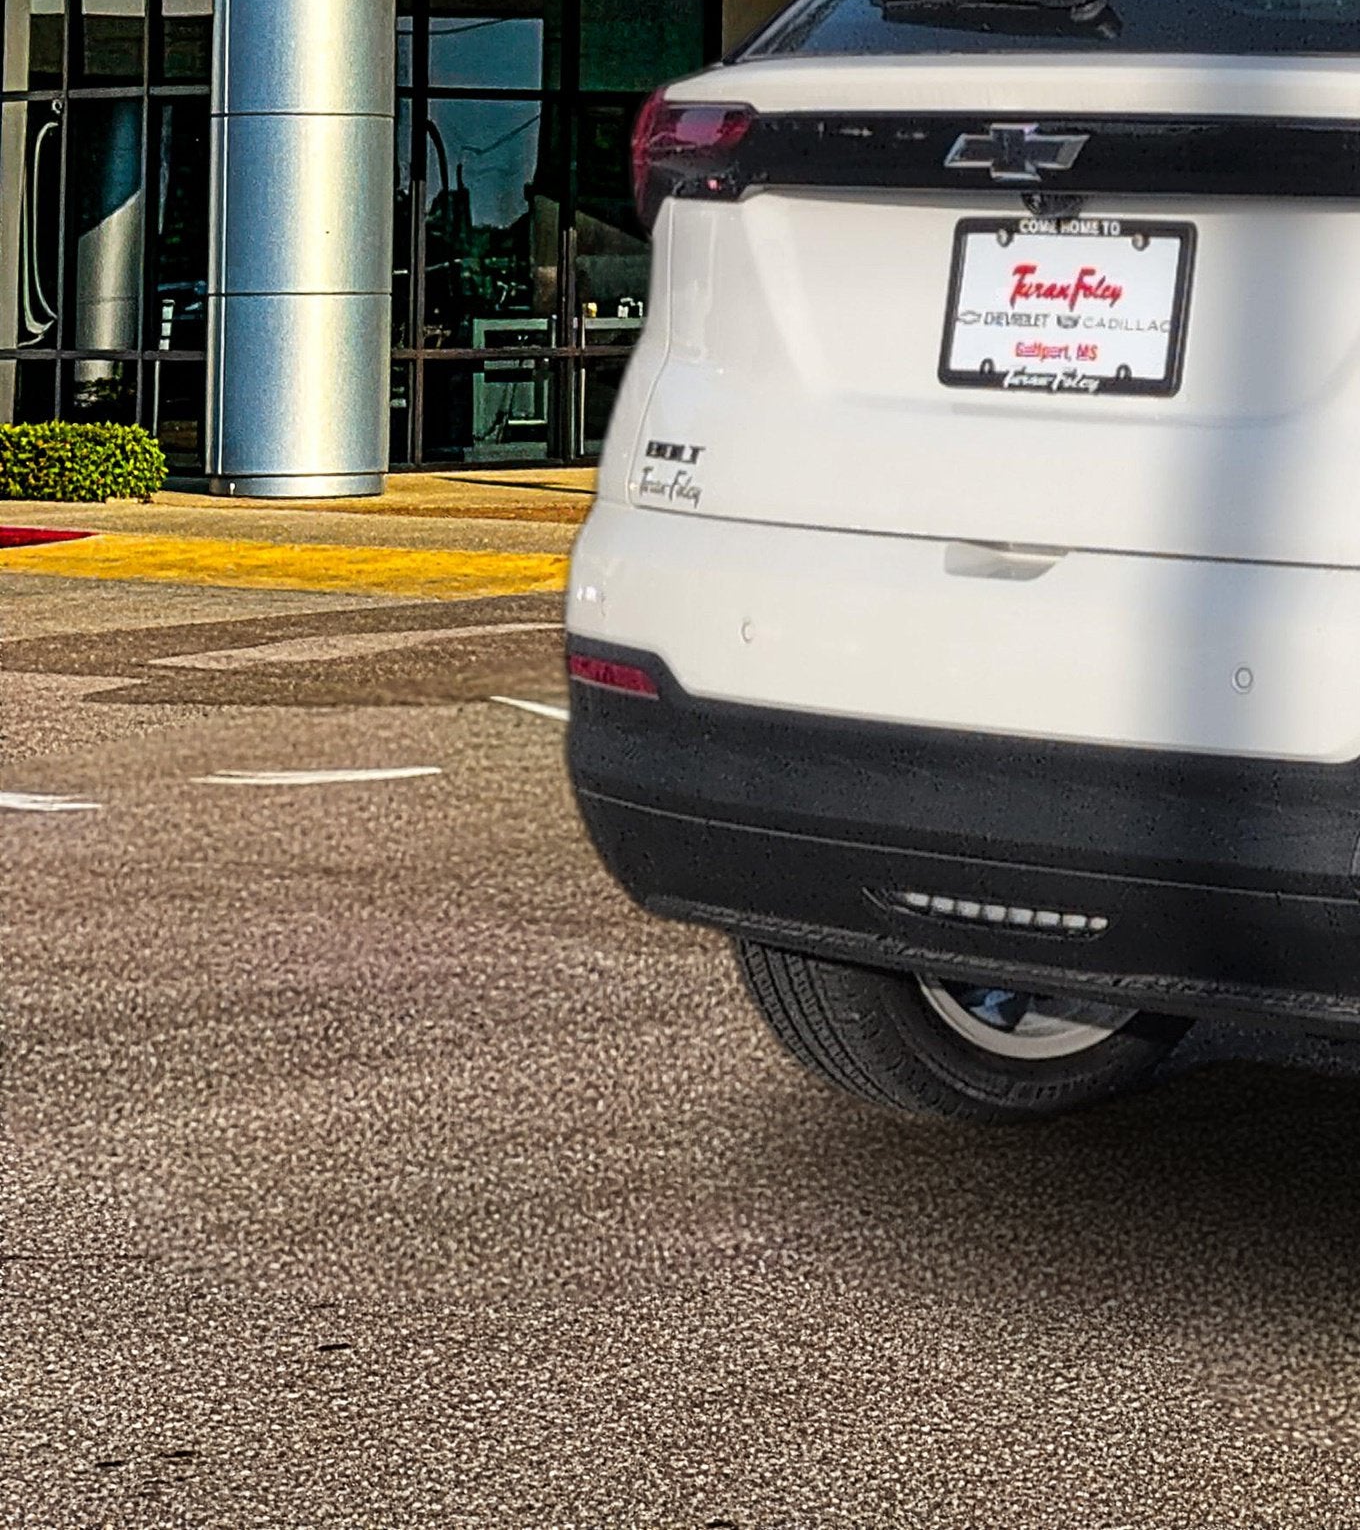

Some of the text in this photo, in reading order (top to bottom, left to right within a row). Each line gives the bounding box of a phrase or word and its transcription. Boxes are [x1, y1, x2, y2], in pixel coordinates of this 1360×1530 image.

[1061, 221, 1099, 235] HOME
[1102, 222, 1121, 236] TO
[1083, 317, 1171, 334] CADILLAC
[1076, 344, 1098, 362] MS
[645, 440, 706, 464] BOLT
